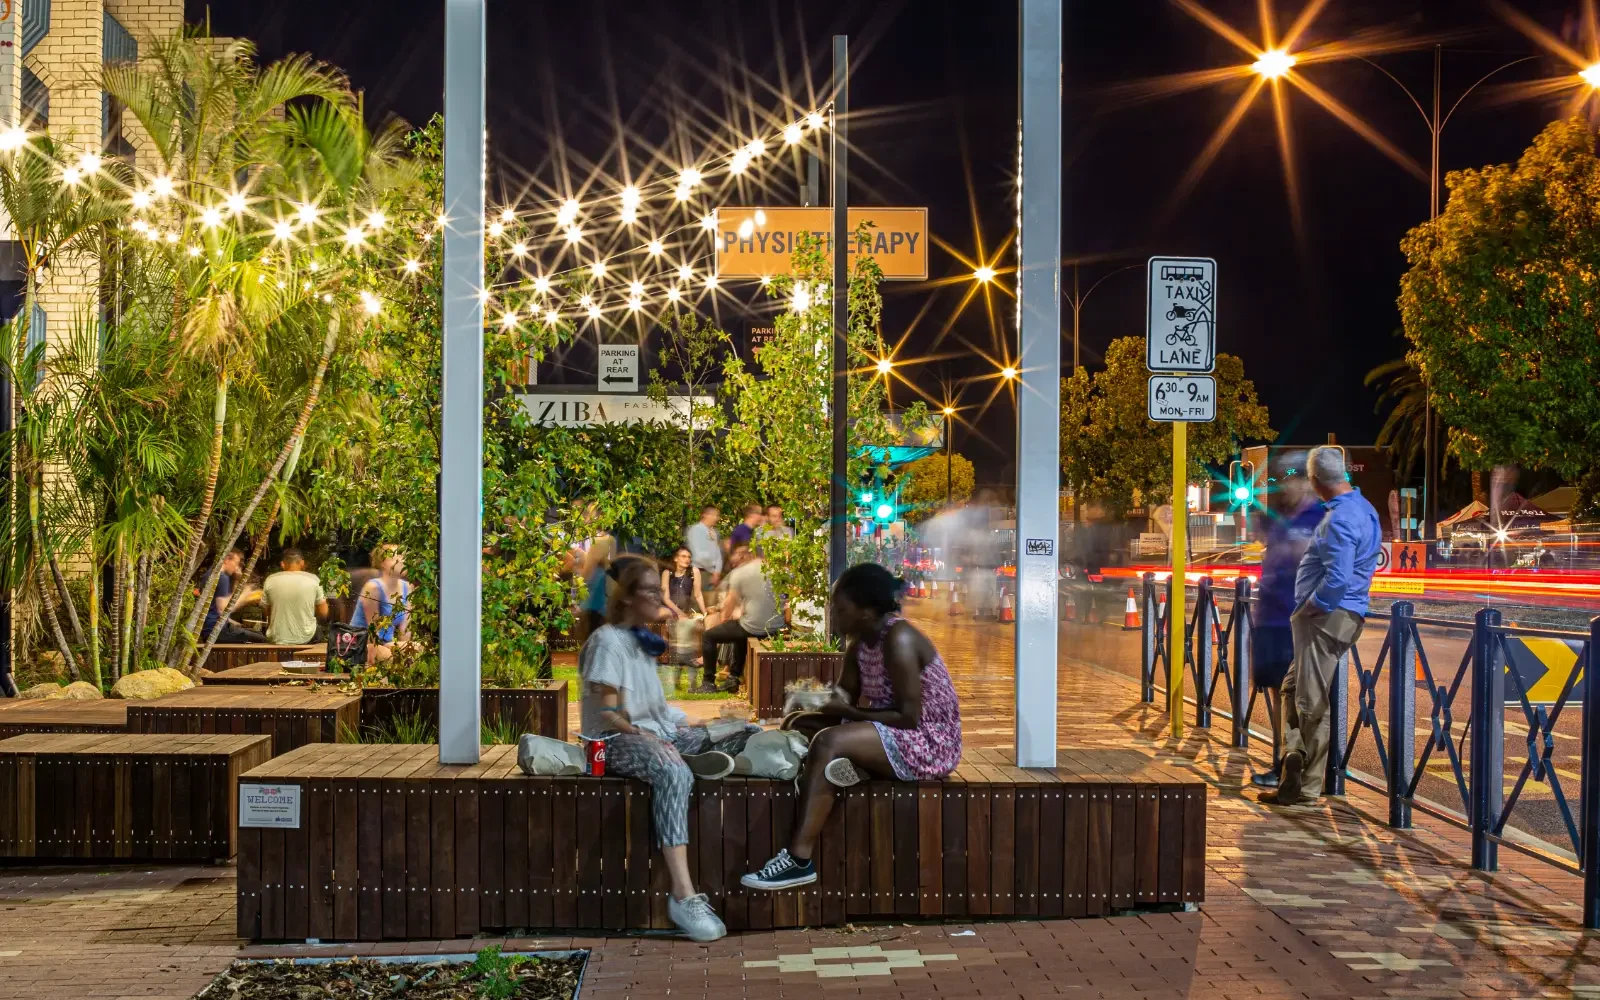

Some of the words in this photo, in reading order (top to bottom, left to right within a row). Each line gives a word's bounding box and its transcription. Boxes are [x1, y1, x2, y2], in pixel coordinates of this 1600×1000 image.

[1165, 286, 1200, 300] TAXI
[1160, 350, 1201, 364] LANE
[538, 401, 608, 422] ZIBA
[247, 795, 293, 804] WELCOME
